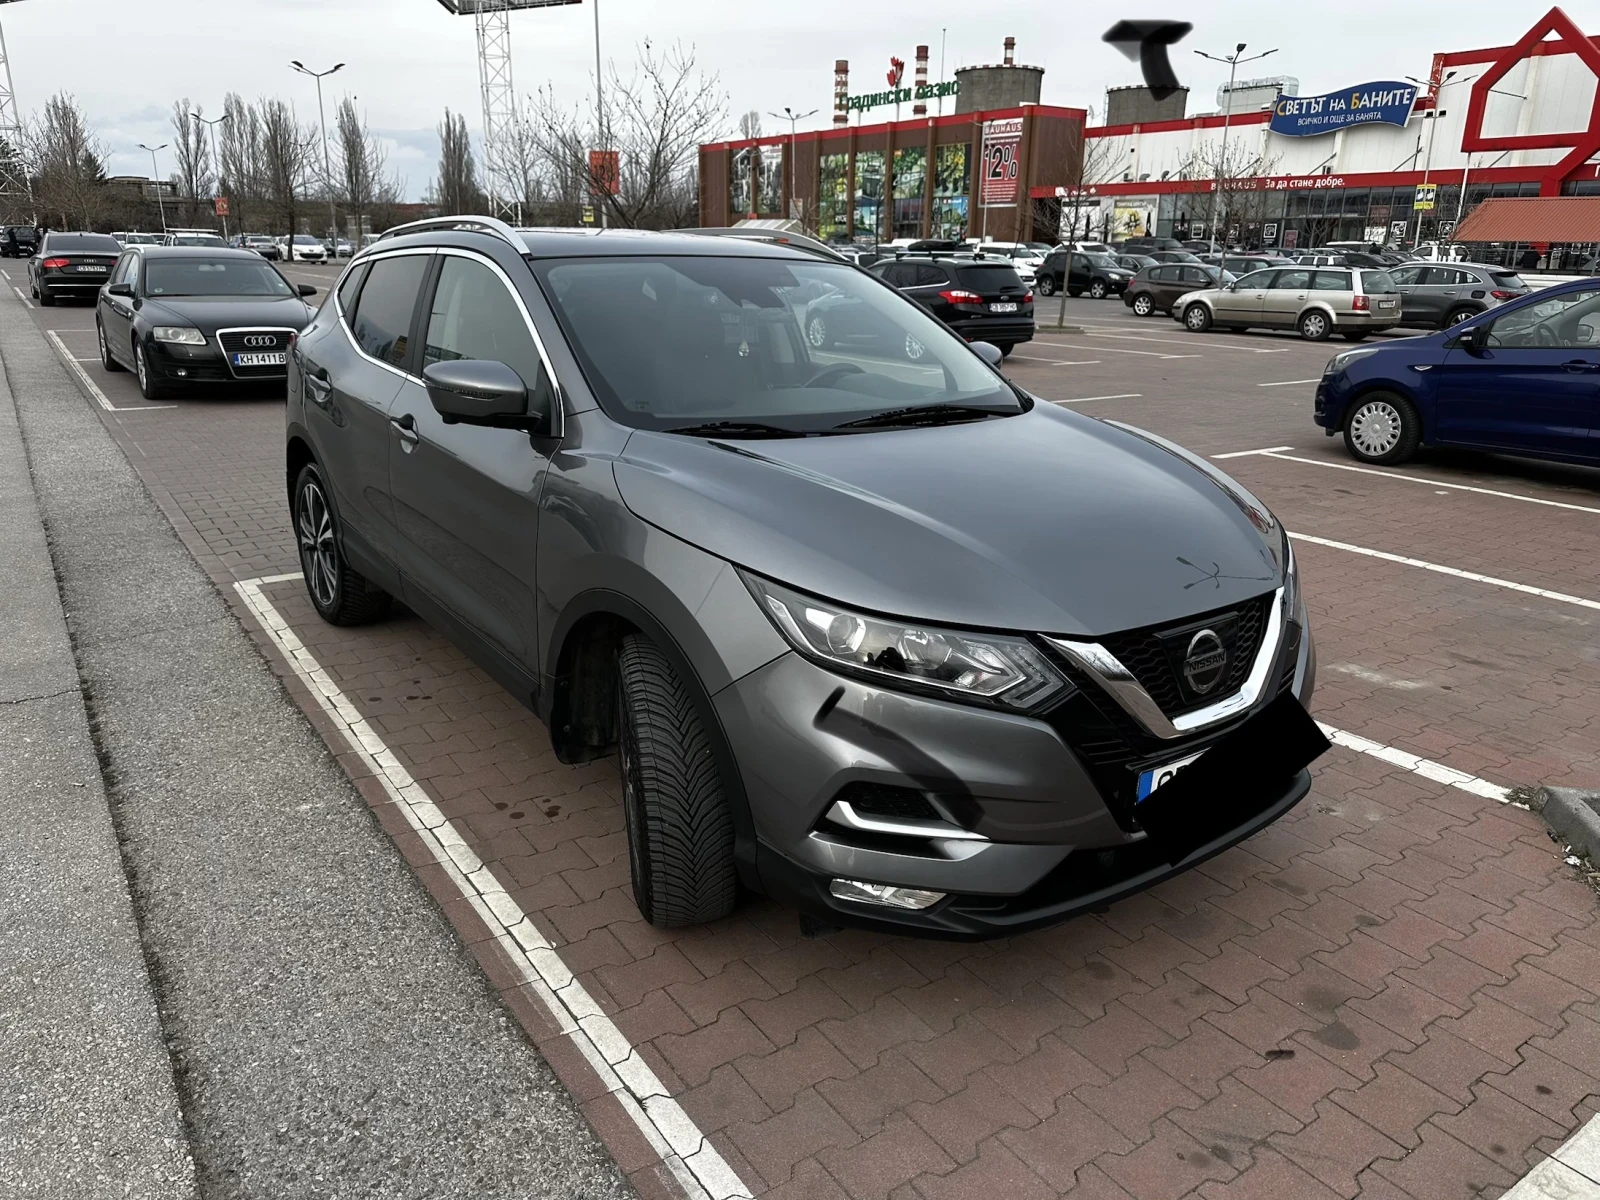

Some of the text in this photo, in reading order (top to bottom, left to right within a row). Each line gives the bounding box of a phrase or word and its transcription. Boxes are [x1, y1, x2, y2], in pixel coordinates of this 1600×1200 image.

[1277, 88, 1411, 116] СВЕТЪТ НА БАНИТЕ
[1297, 111, 1382, 126] ВСИЧКО И ОЩЕ ЗА БАНЯТА
[985, 123, 1022, 134] BAUHAUS
[985, 143, 1018, 180] 12%
[1265, 175, 1345, 190] За да стане добре.
[239, 354, 254, 364] KH
[256, 354, 277, 363] 1411
[1190, 650, 1225, 672] NISSAN
